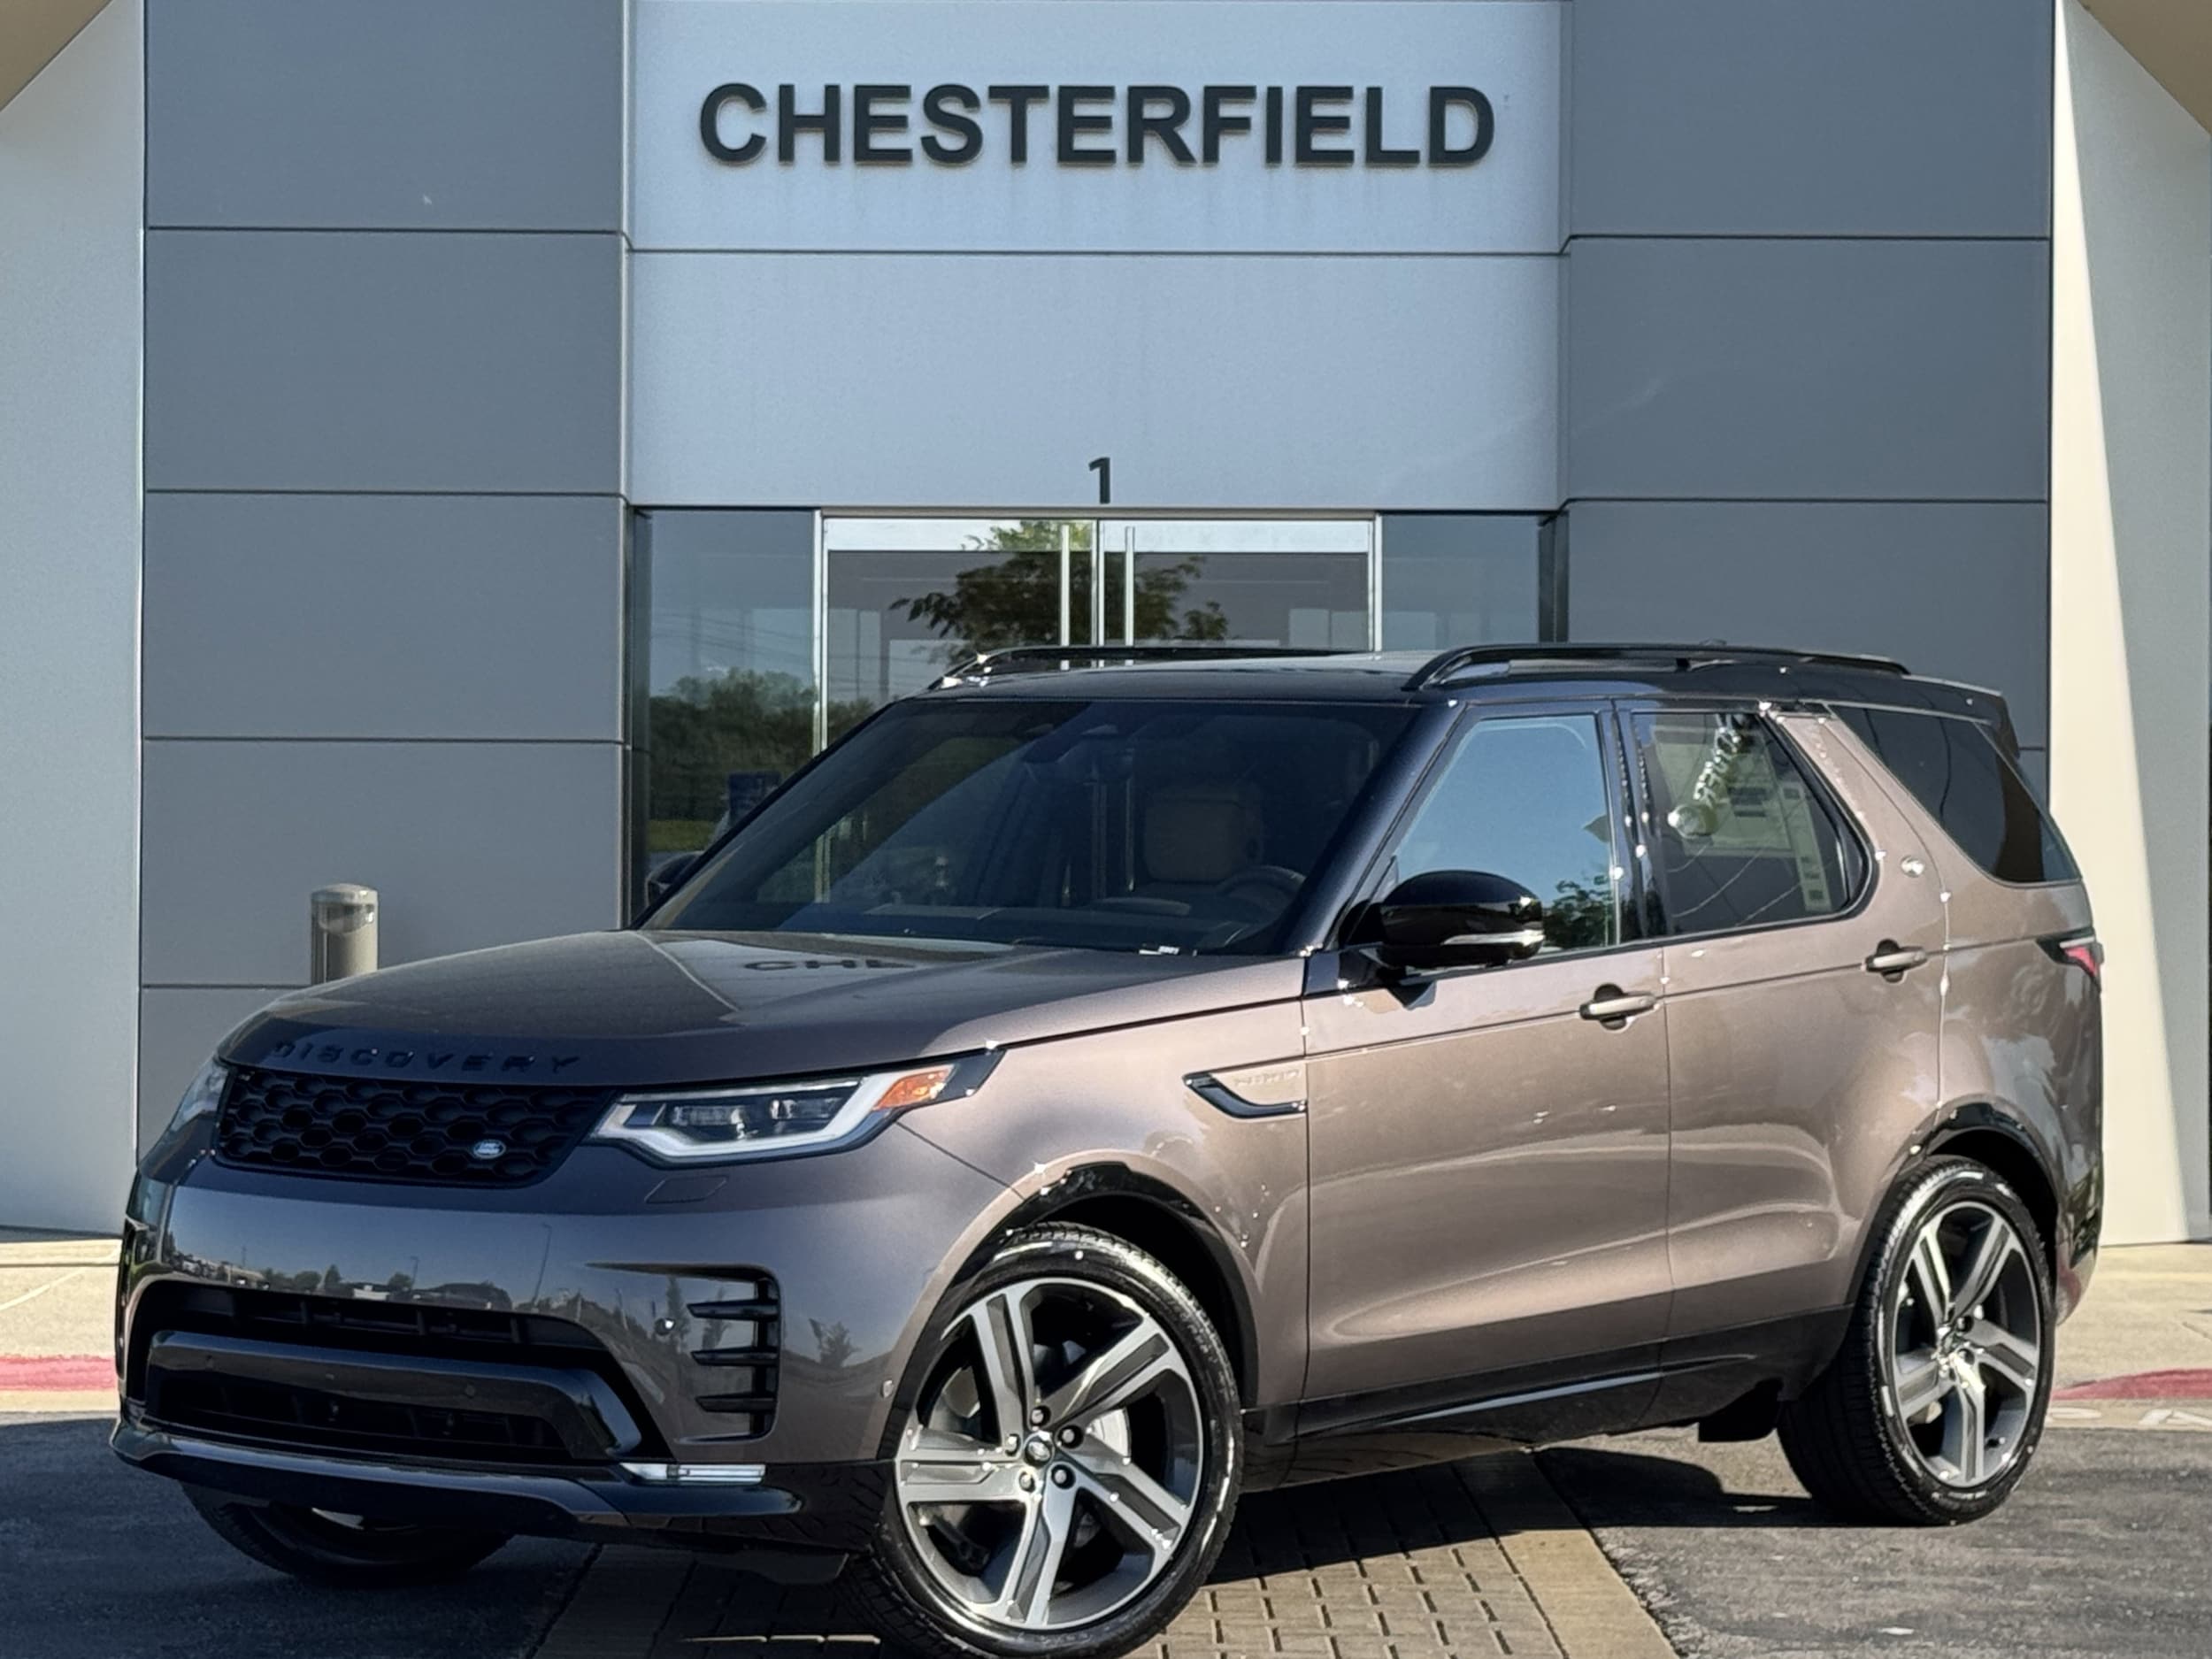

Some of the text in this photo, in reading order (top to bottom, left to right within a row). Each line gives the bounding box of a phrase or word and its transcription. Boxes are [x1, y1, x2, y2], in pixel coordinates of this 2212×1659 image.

[700, 82, 1494, 166] CHESTERFIELD
[1088, 457, 1110, 504] 1
[270, 1040, 581, 1074] DISCOVERY
